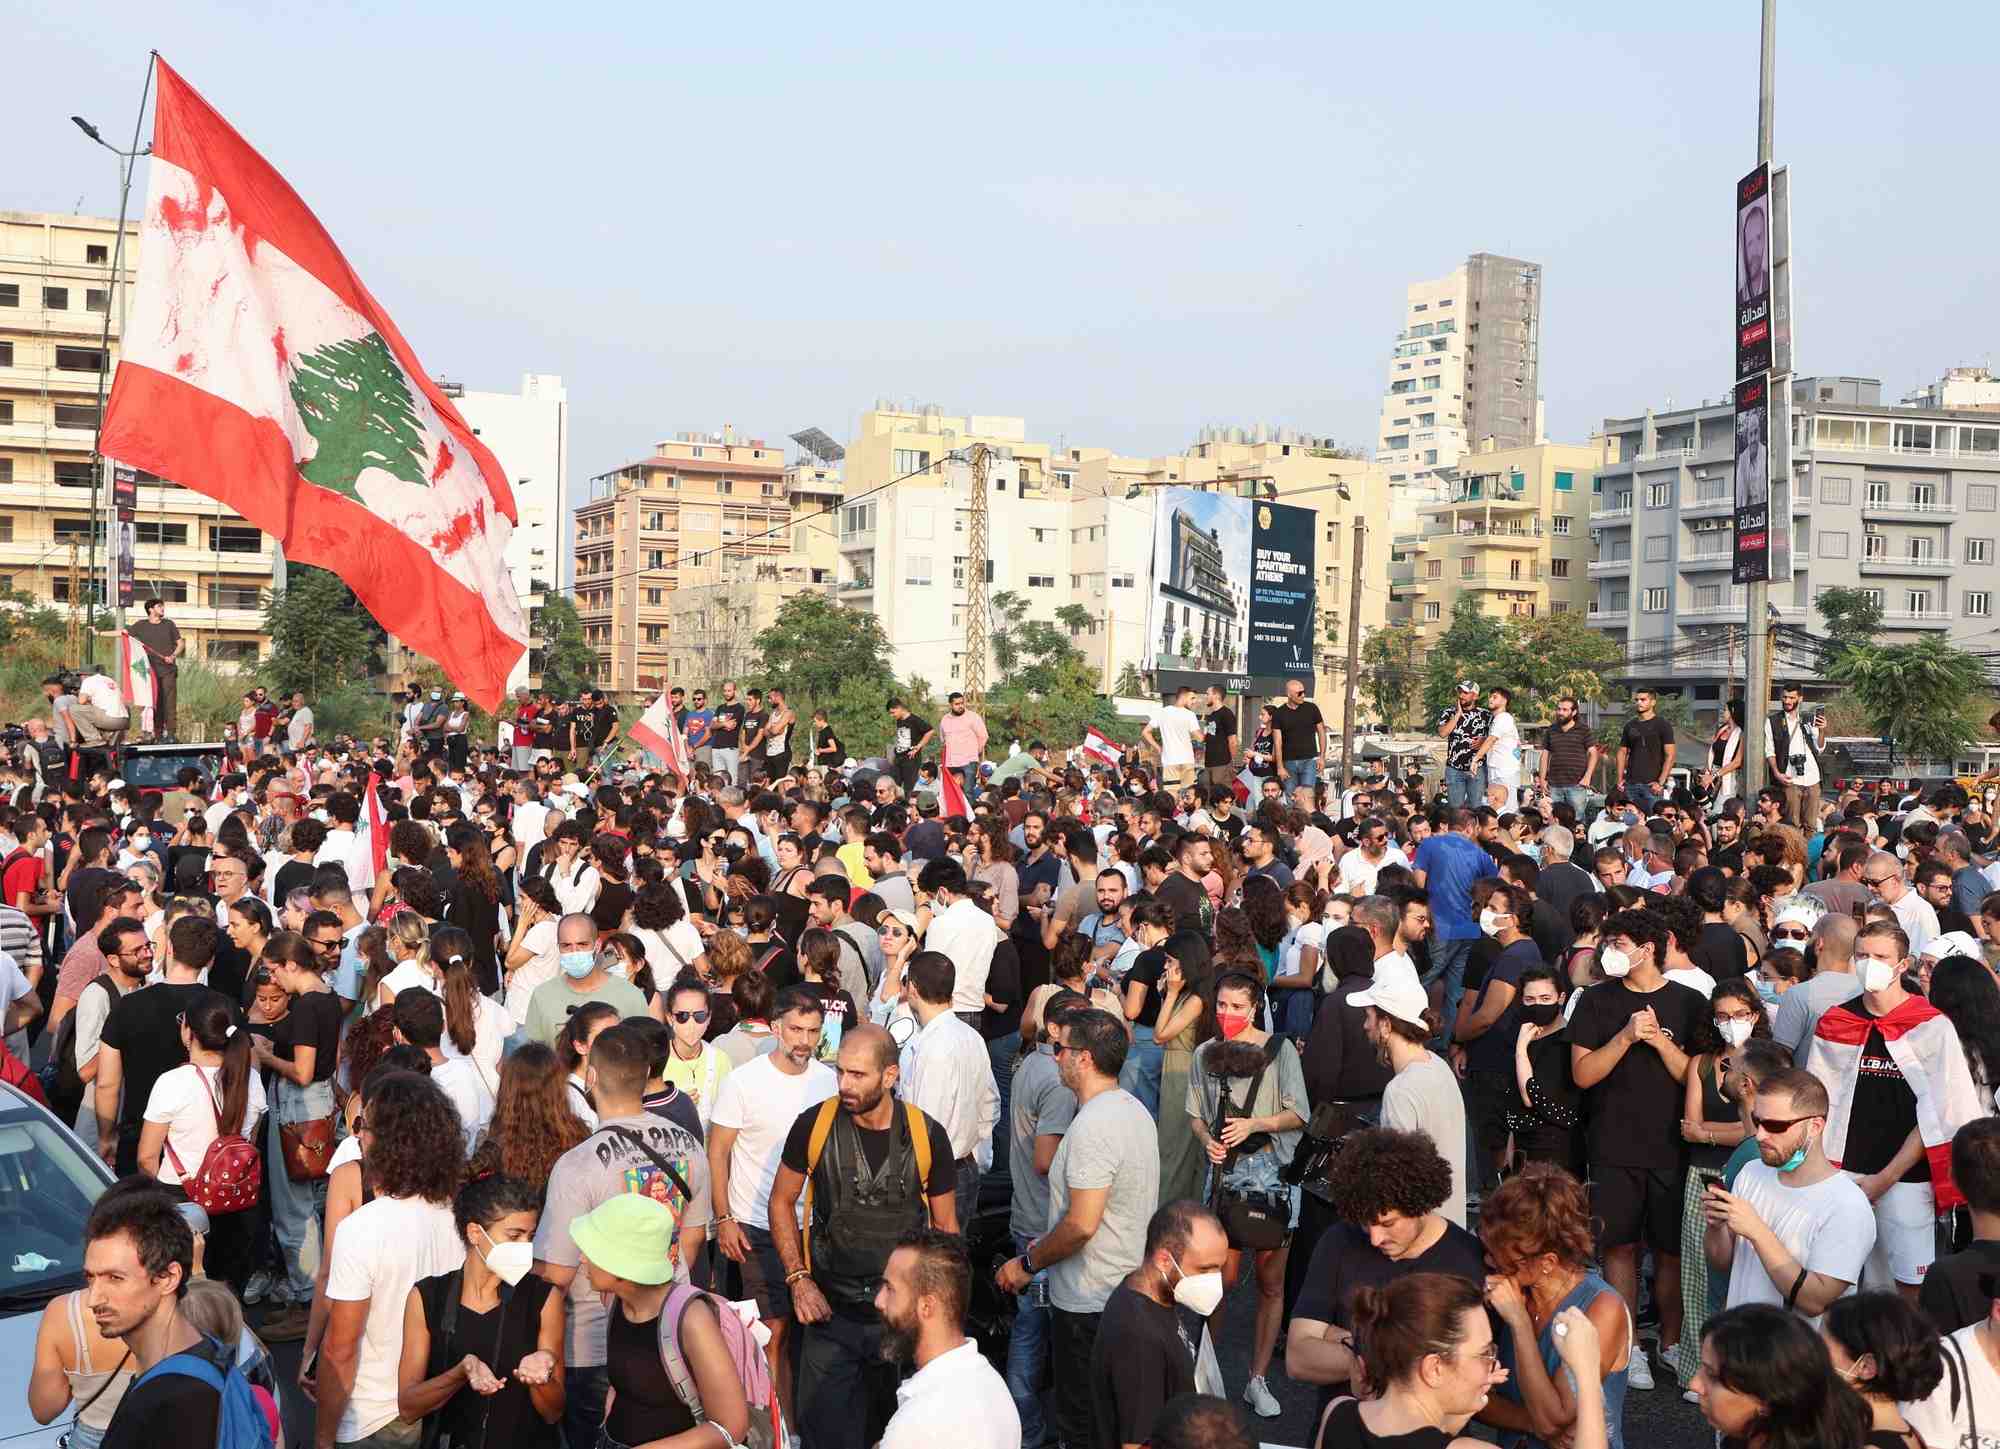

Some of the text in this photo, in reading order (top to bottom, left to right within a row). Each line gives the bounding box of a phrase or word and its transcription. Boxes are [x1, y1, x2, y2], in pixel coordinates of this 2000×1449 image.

[1741, 299, 1767, 326] العدالة
[1740, 511, 1766, 530] العدالة
[1256, 548, 1291, 562] BUY YOUR
[1256, 560, 1298, 574] APARTMENT
[1256, 570, 1284, 583] ATHENS
[1860, 1058, 1898, 1071] LEBANO
